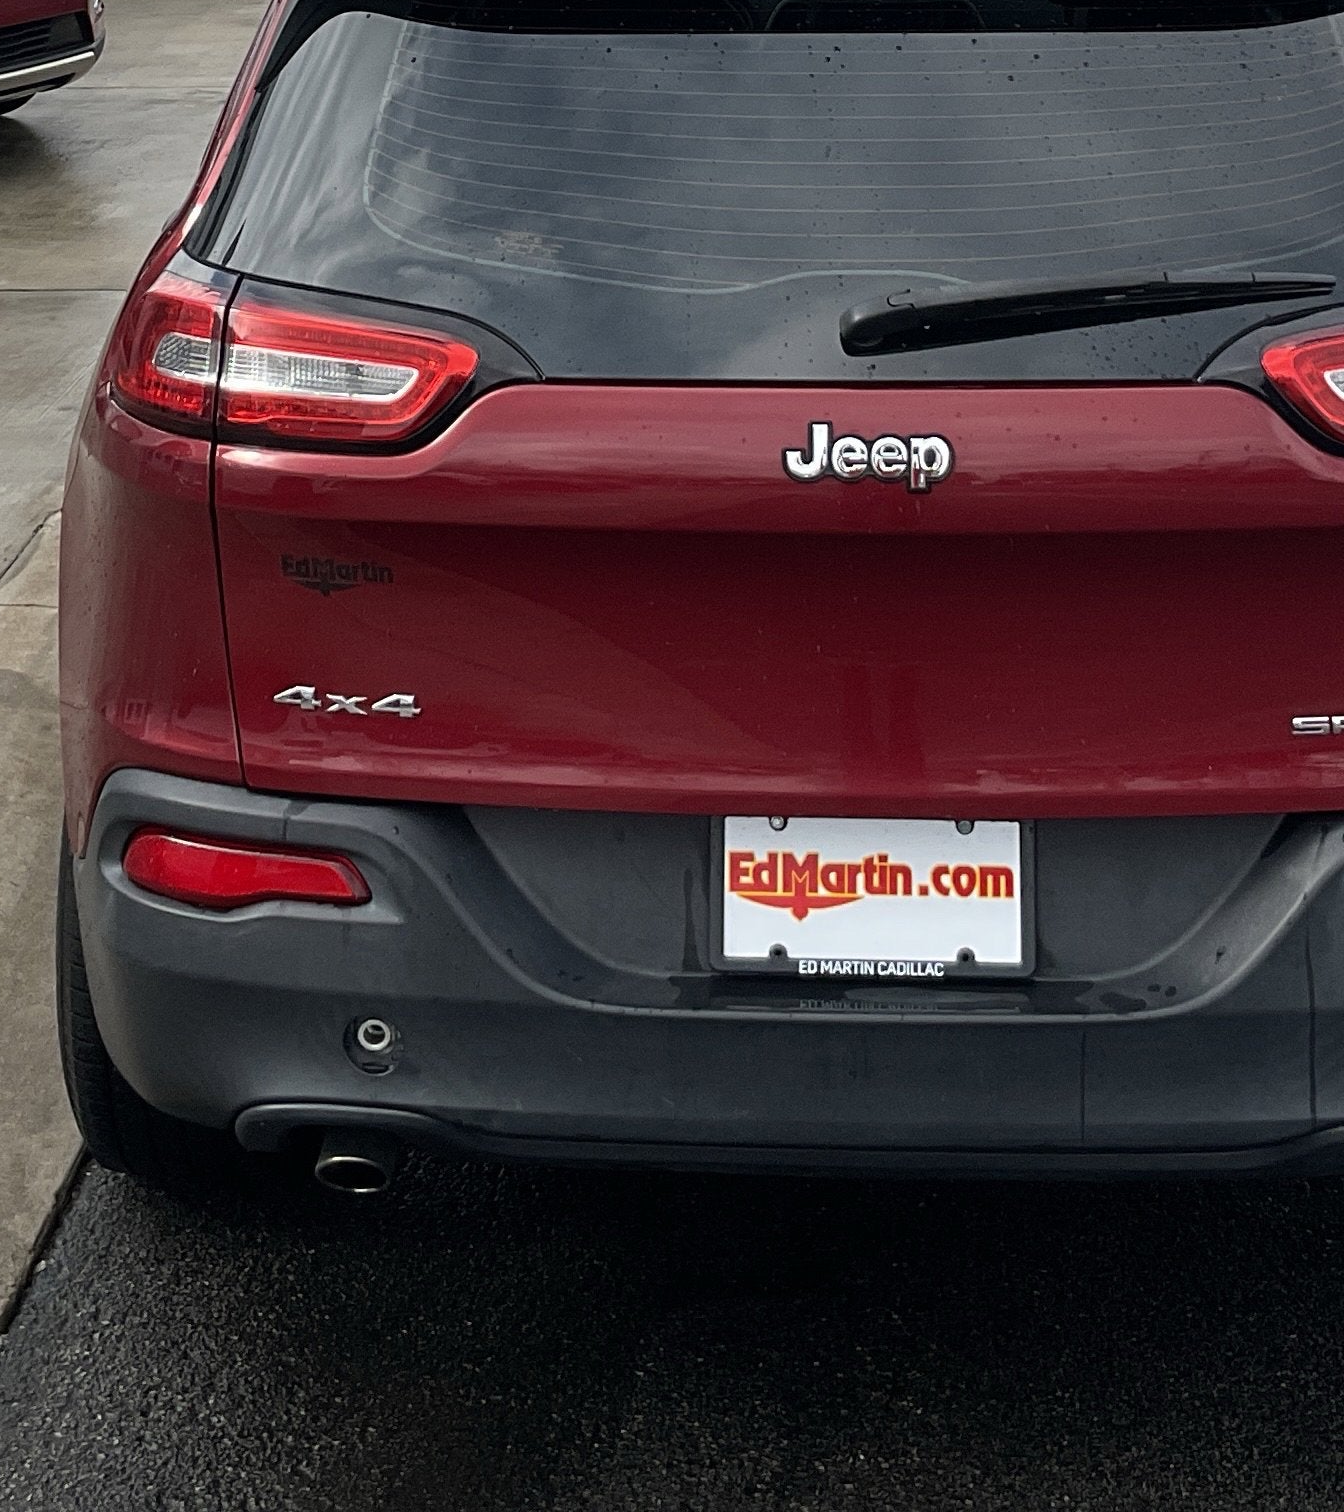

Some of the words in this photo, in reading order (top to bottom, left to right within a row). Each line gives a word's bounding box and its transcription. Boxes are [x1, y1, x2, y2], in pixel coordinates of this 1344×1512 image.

[783, 421, 953, 491] Jeep
[280, 553, 394, 585] EdMartin
[273, 685, 423, 719] 4x4
[728, 849, 1016, 900] EdMartin.com
[798, 959, 817, 975] ED
[819, 960, 873, 977] MARTIN
[876, 961, 945, 978] CADILLAC
